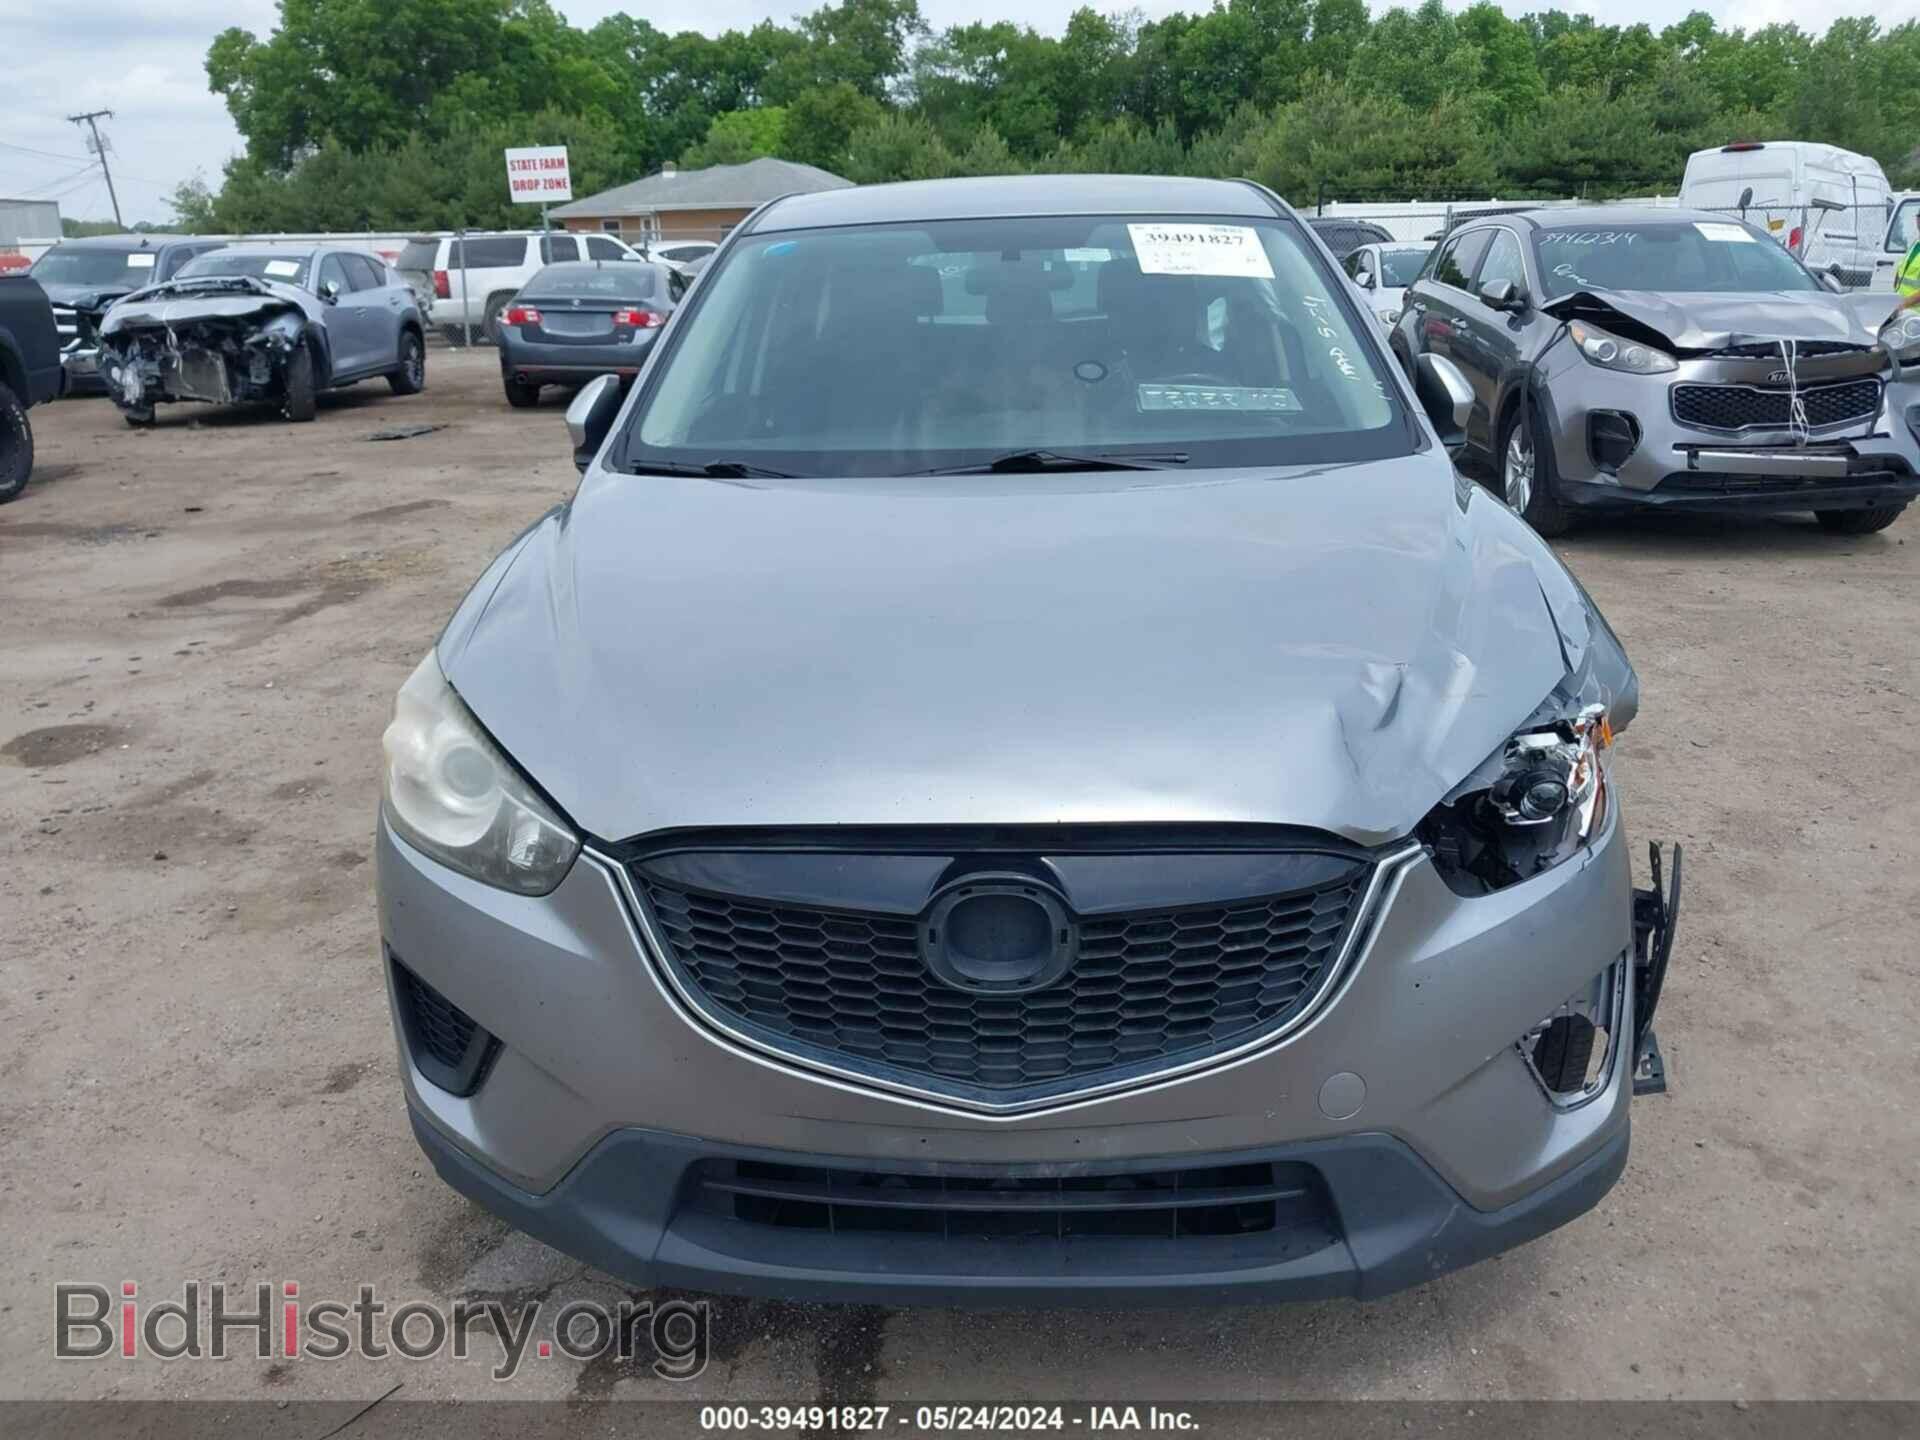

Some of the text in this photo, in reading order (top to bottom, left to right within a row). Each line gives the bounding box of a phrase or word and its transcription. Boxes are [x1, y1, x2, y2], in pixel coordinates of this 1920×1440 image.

[509, 157, 566, 172] STATE FARM
[512, 177, 568, 192] DROP ZONE
[1145, 232, 1245, 246] 39491827
